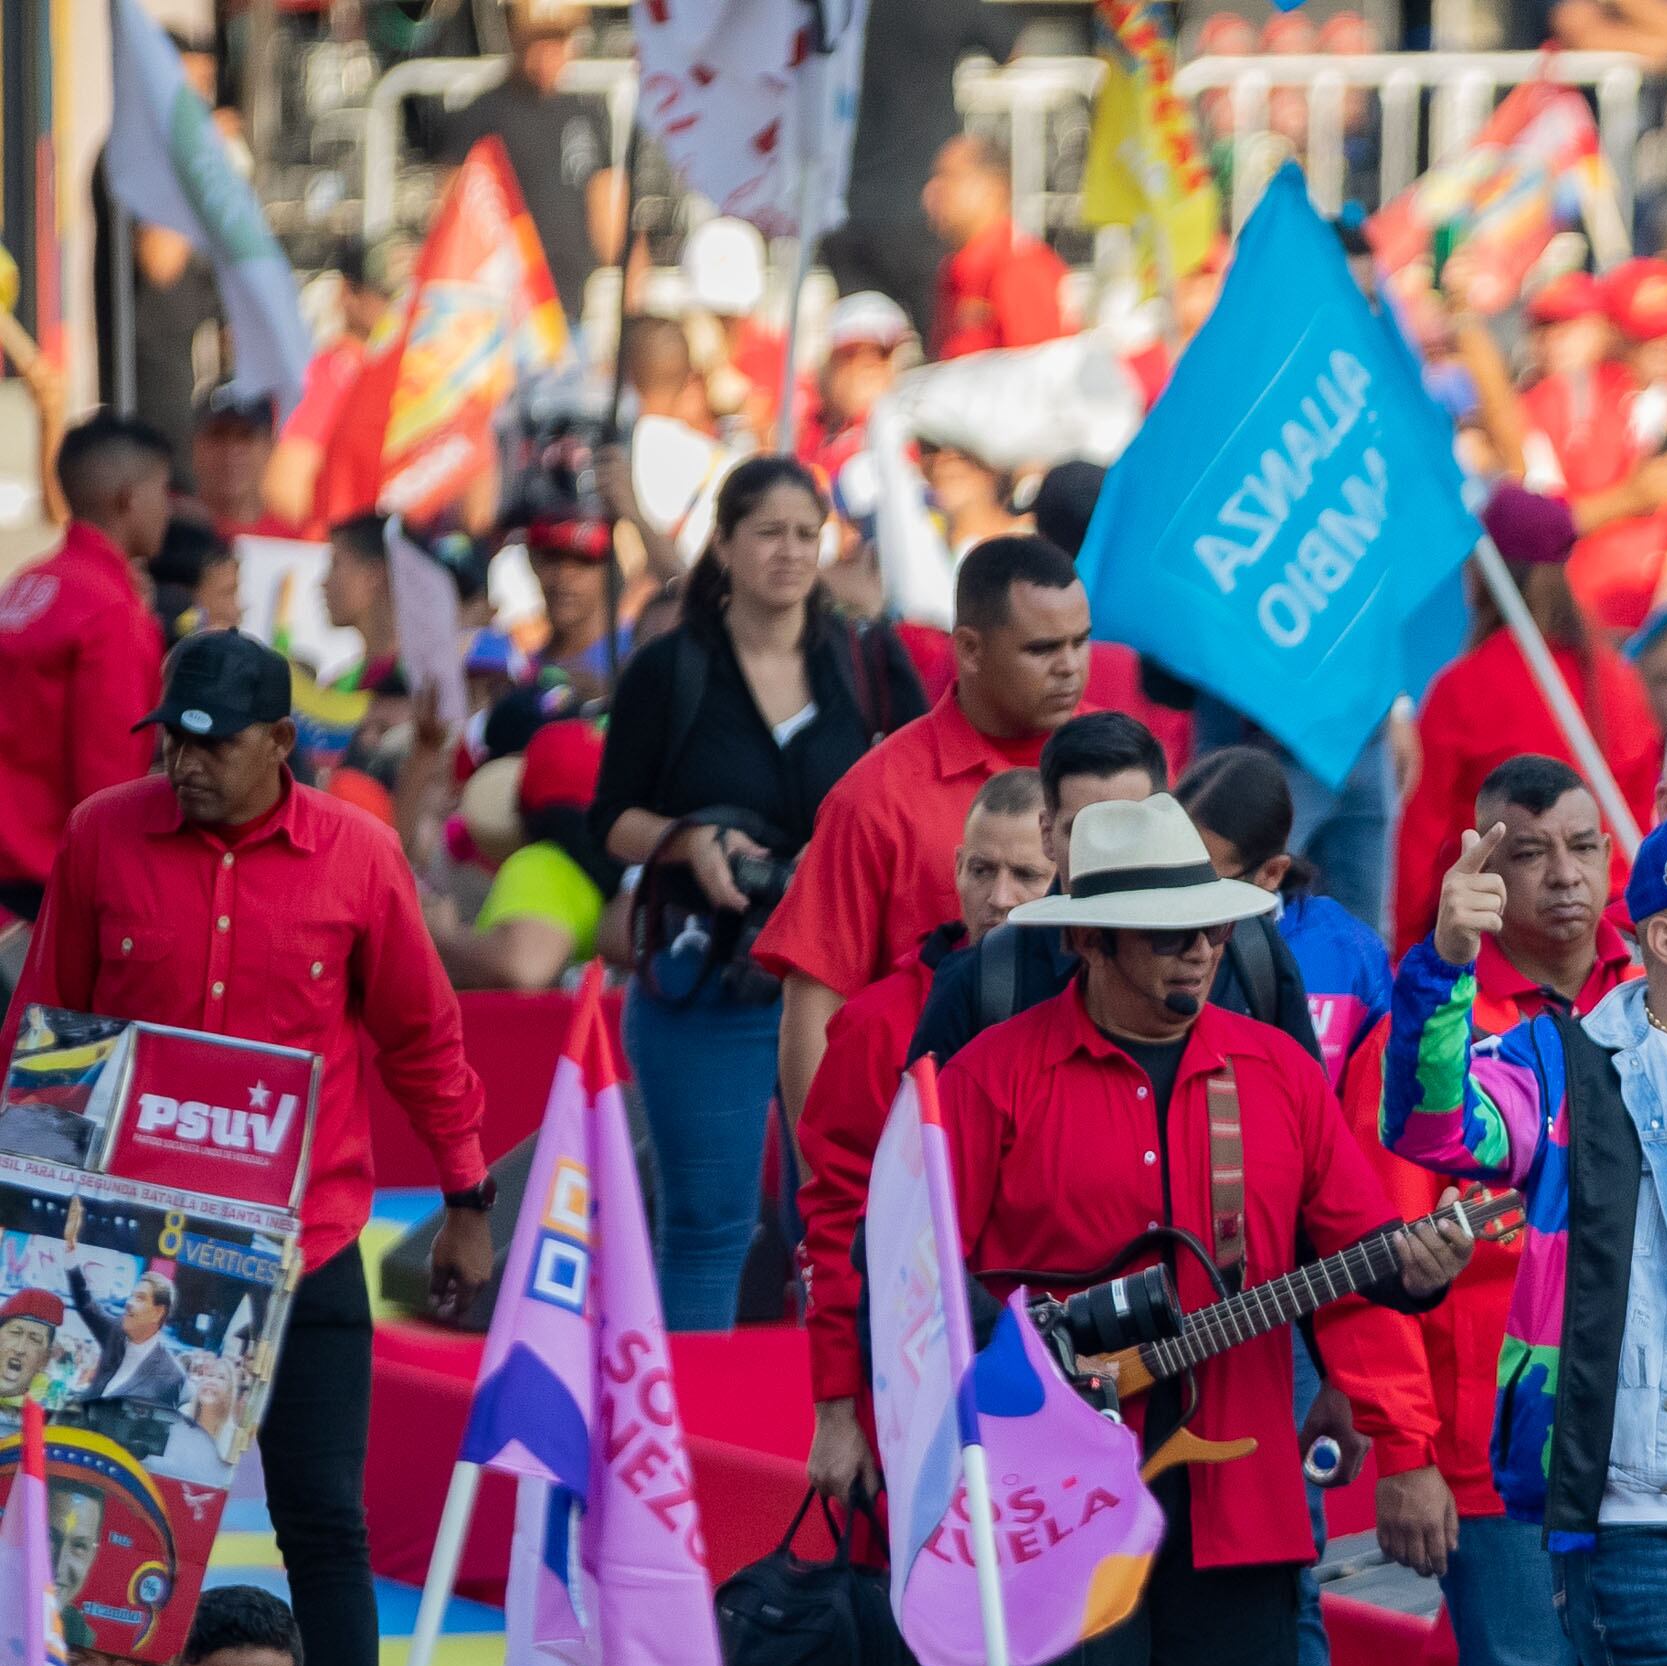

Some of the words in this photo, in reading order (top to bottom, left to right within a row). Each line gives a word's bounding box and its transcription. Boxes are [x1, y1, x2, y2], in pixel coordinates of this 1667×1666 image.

[23, 1161, 56, 1178] PARA
[59, 1168, 75, 1183] LA
[78, 1172, 137, 1196] SEGUNDA
[141, 1185, 195, 1209] BATALLA
[199, 1200, 217, 1214] DE
[220, 1204, 262, 1224] SANTA
[159, 1210, 186, 1256] 8
[186, 1238, 280, 1285] VÉRTICES
